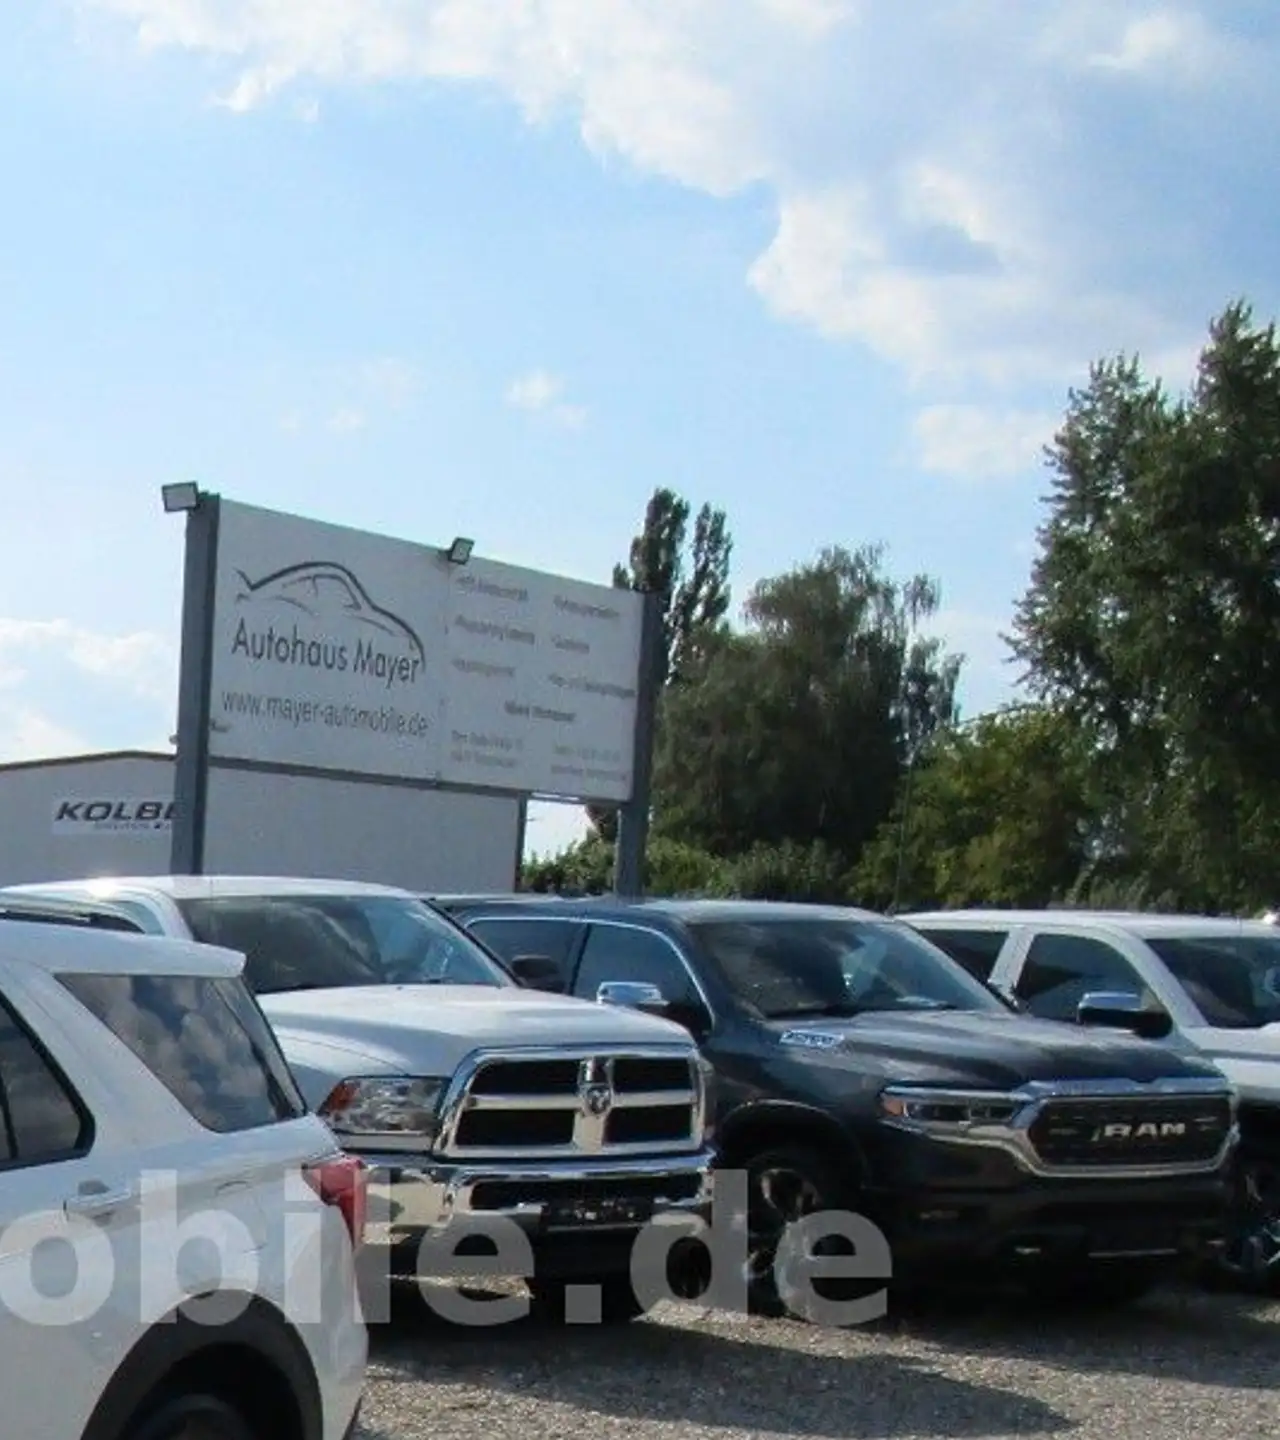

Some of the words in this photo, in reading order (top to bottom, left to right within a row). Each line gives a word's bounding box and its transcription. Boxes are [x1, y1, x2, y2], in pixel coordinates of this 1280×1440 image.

[231, 616, 348, 672] Autohaus
[353, 638, 421, 690] Mayer
[1103, 1122, 1186, 1138] RAM
